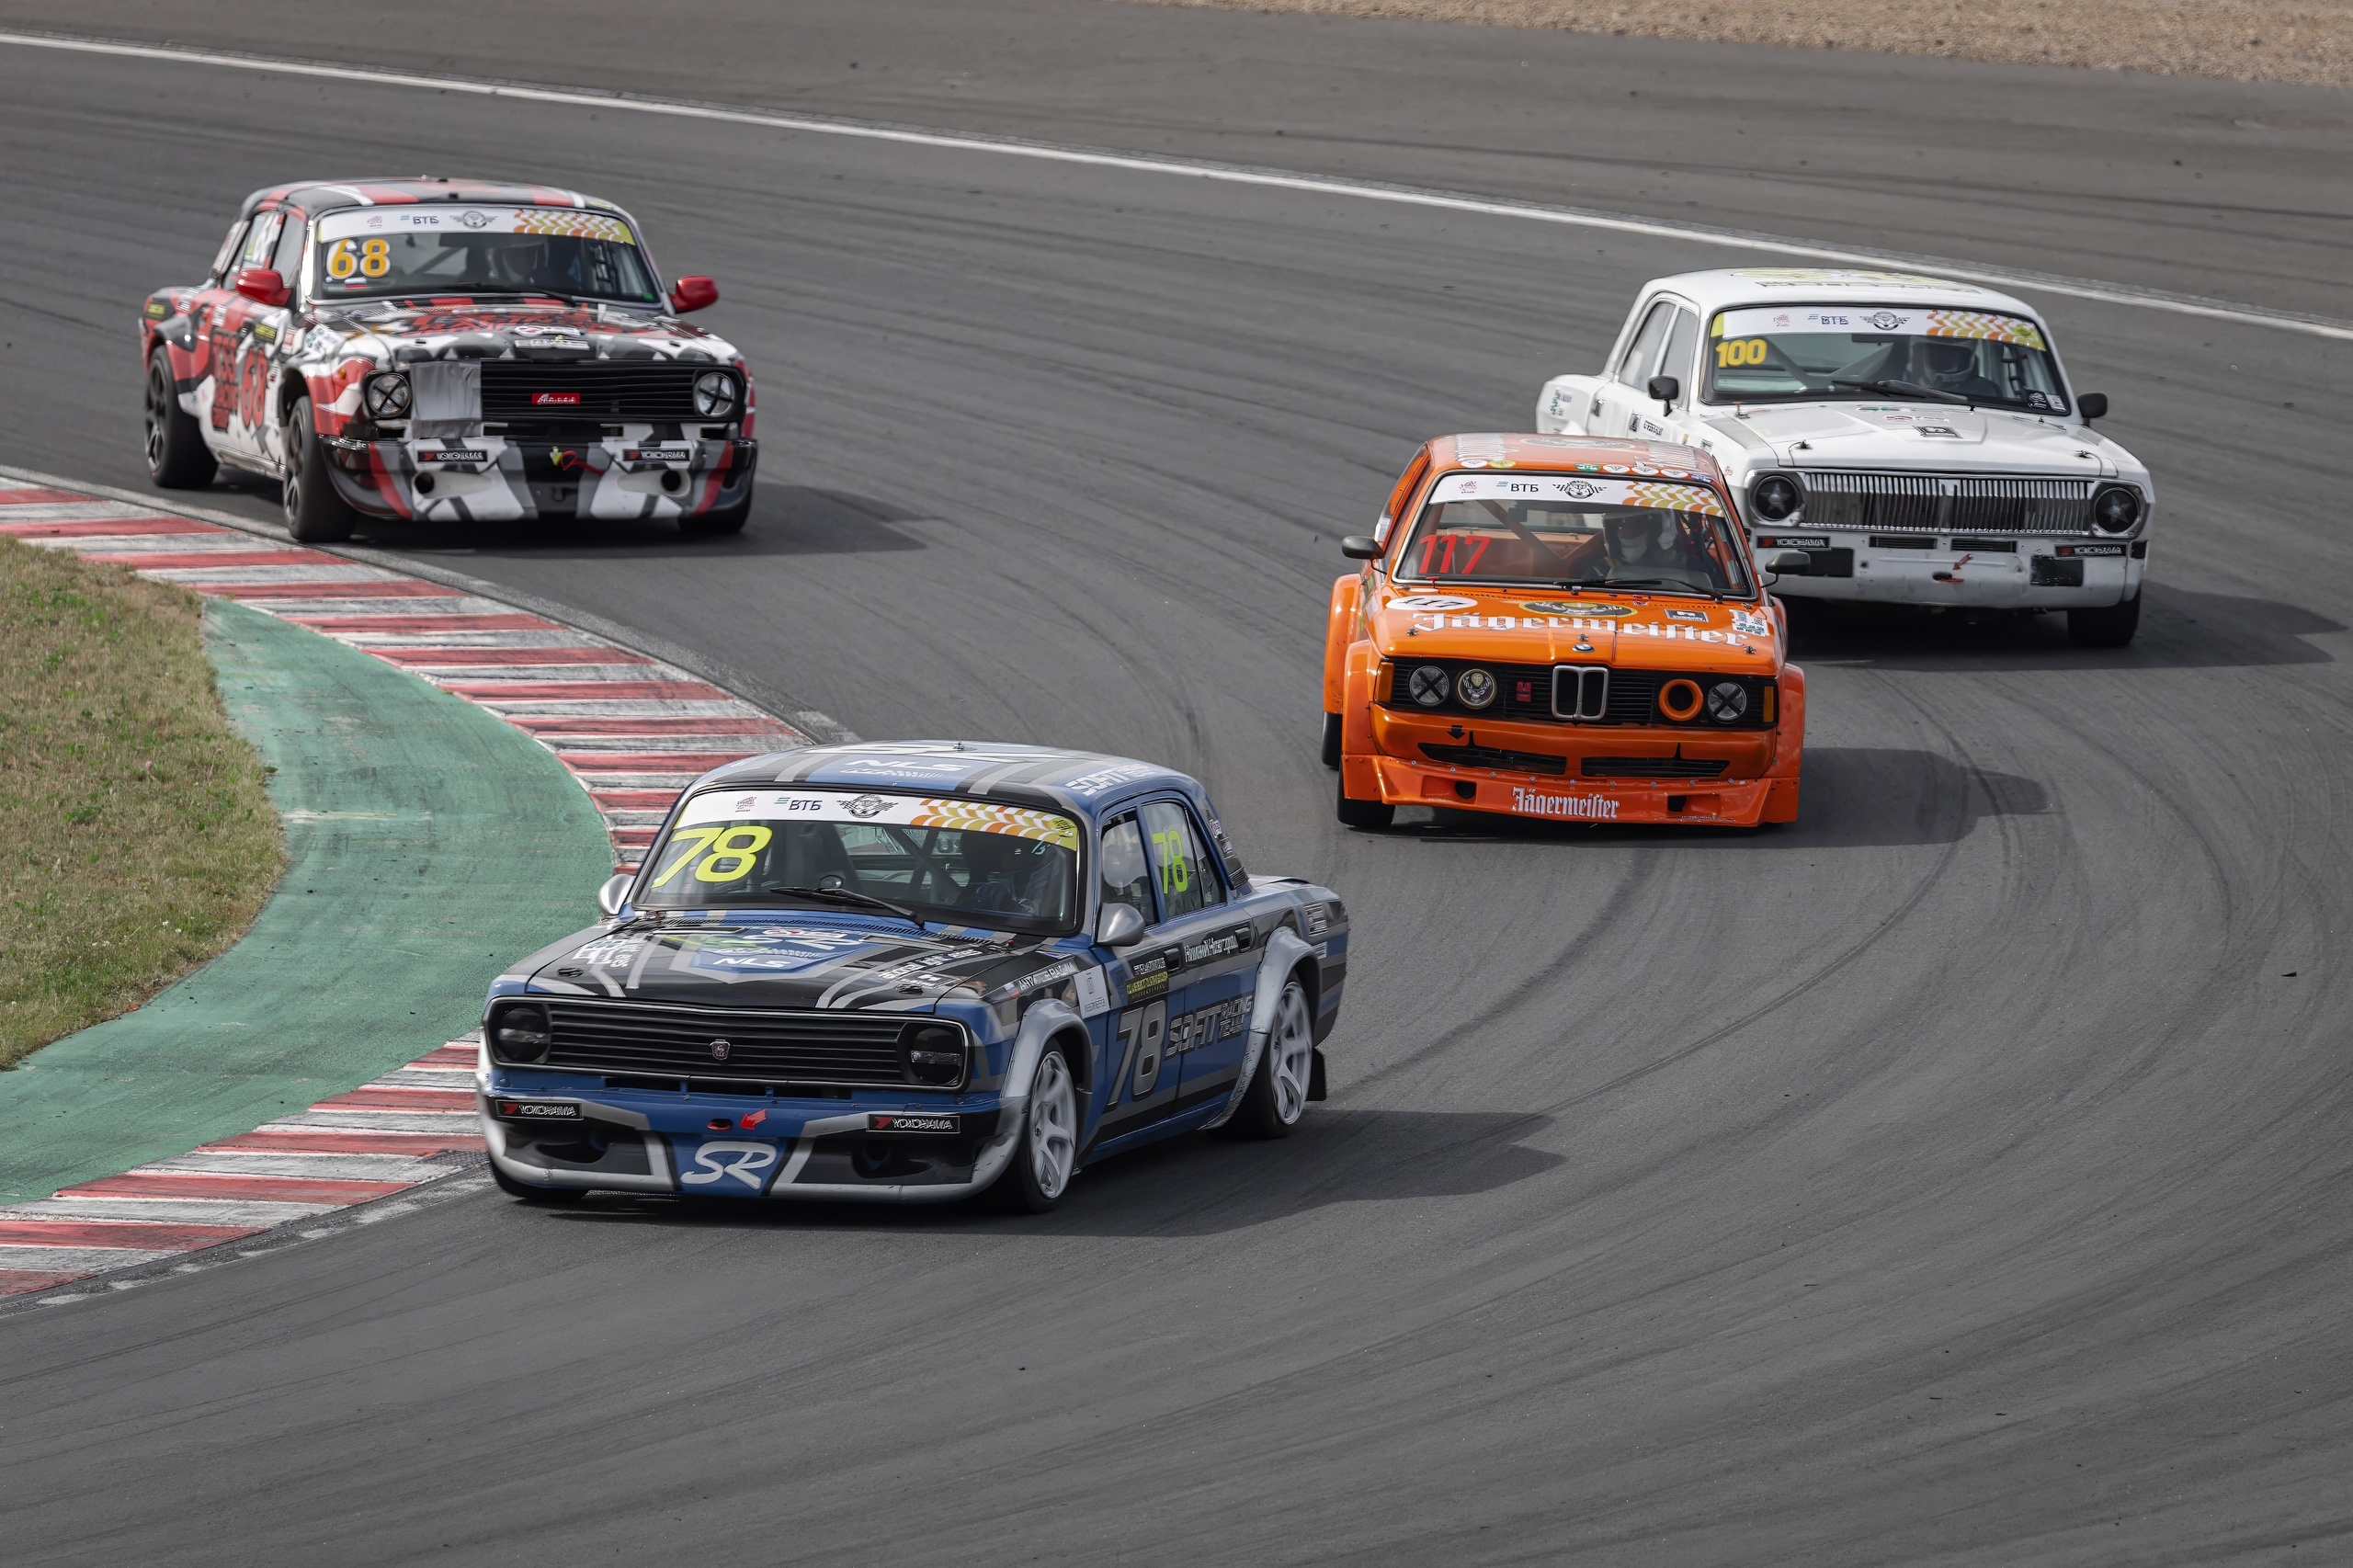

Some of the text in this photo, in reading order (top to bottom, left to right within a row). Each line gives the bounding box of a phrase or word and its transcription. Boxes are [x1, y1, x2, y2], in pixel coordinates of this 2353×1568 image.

[326, 238, 392, 279] 68
[1715, 338, 1768, 368] 100
[241, 347, 267, 428] 68
[1510, 483, 1540, 494] ВТБ
[1418, 534, 1493, 575] 117
[844, 759, 972, 771] NLS
[789, 800, 823, 811] ВТБ
[651, 825, 773, 889] 78
[1152, 830, 1188, 894] 78
[1105, 1000, 1166, 1108] 78
[680, 1140, 778, 1189] SR
